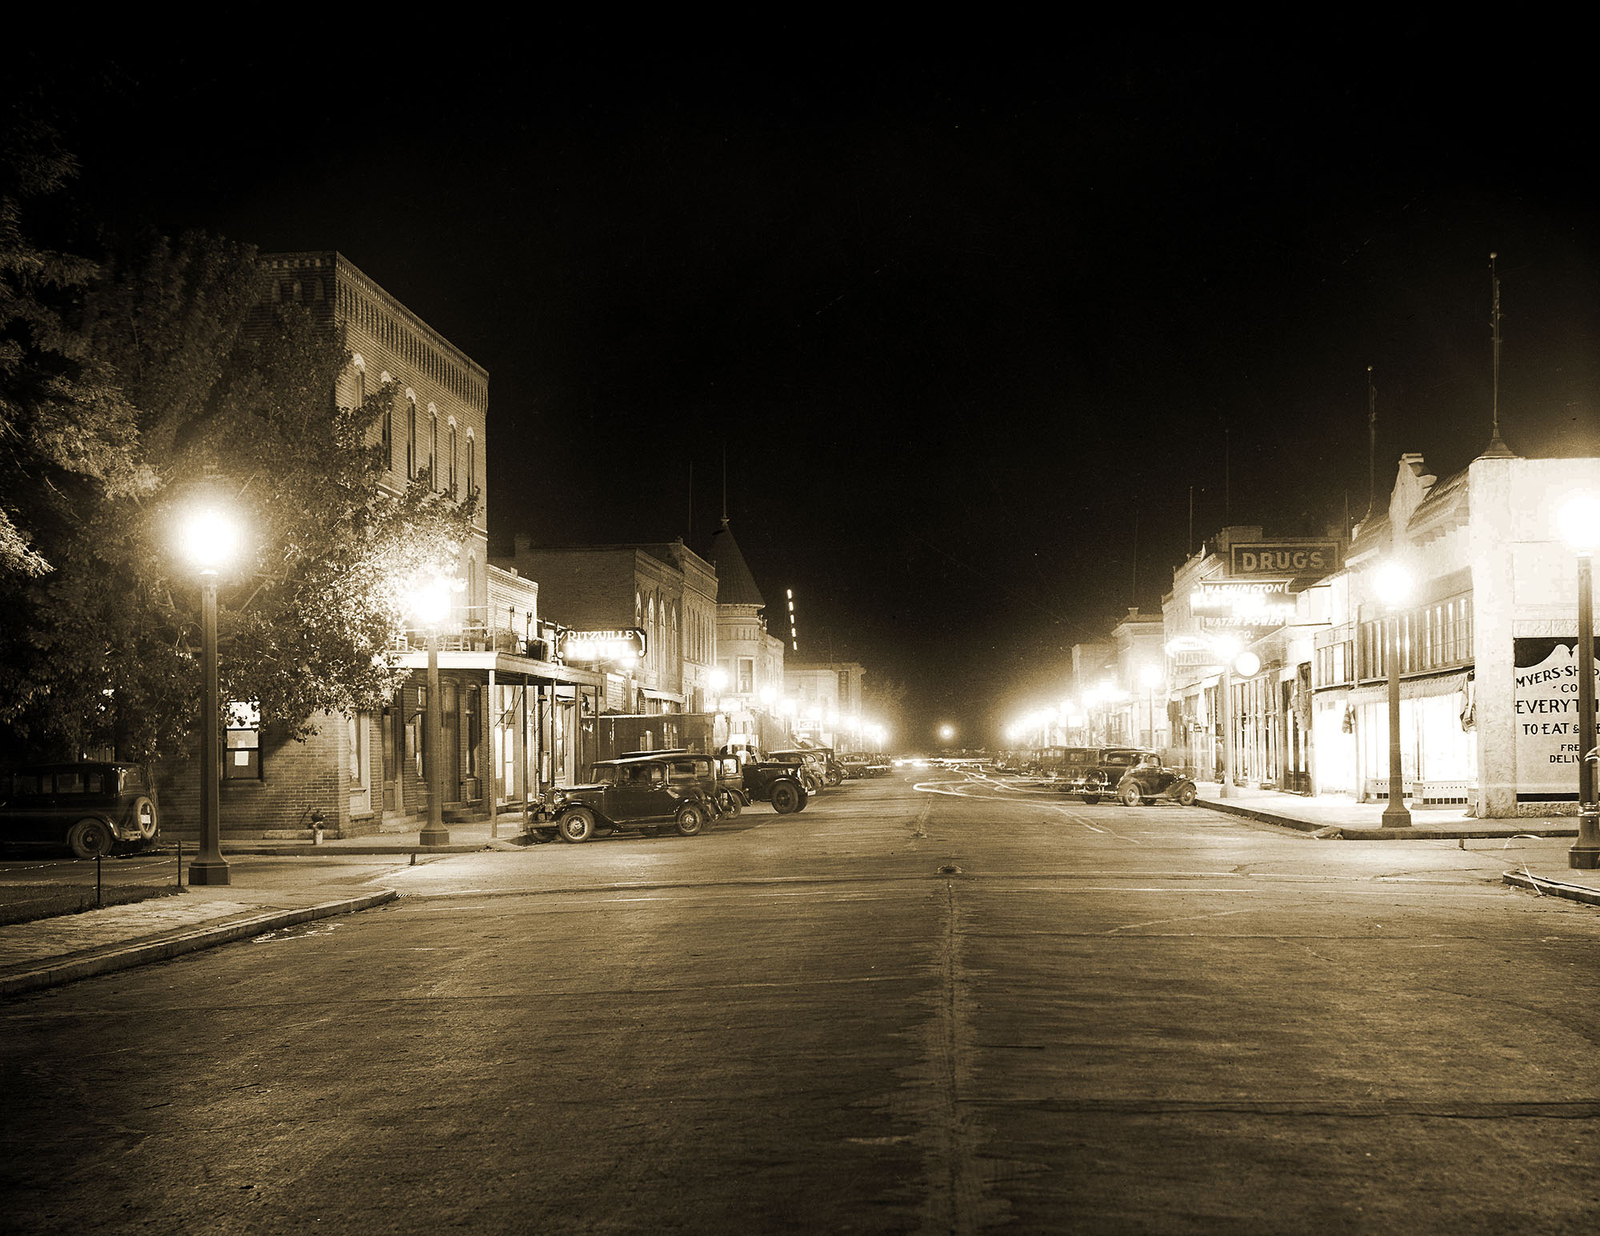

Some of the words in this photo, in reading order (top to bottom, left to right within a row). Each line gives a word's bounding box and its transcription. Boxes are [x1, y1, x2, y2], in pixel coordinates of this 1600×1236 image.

[1242, 551, 1324, 571] DRUGS
[1204, 583, 1283, 595] WASHINGTON
[1205, 617, 1242, 627] WATER
[1243, 616, 1284, 626] POWER
[568, 630, 634, 641] RITZVILLE
[1522, 724, 1538, 735] TO
[1541, 723, 1569, 735] EAT
[1561, 744, 1580, 752] FRE
